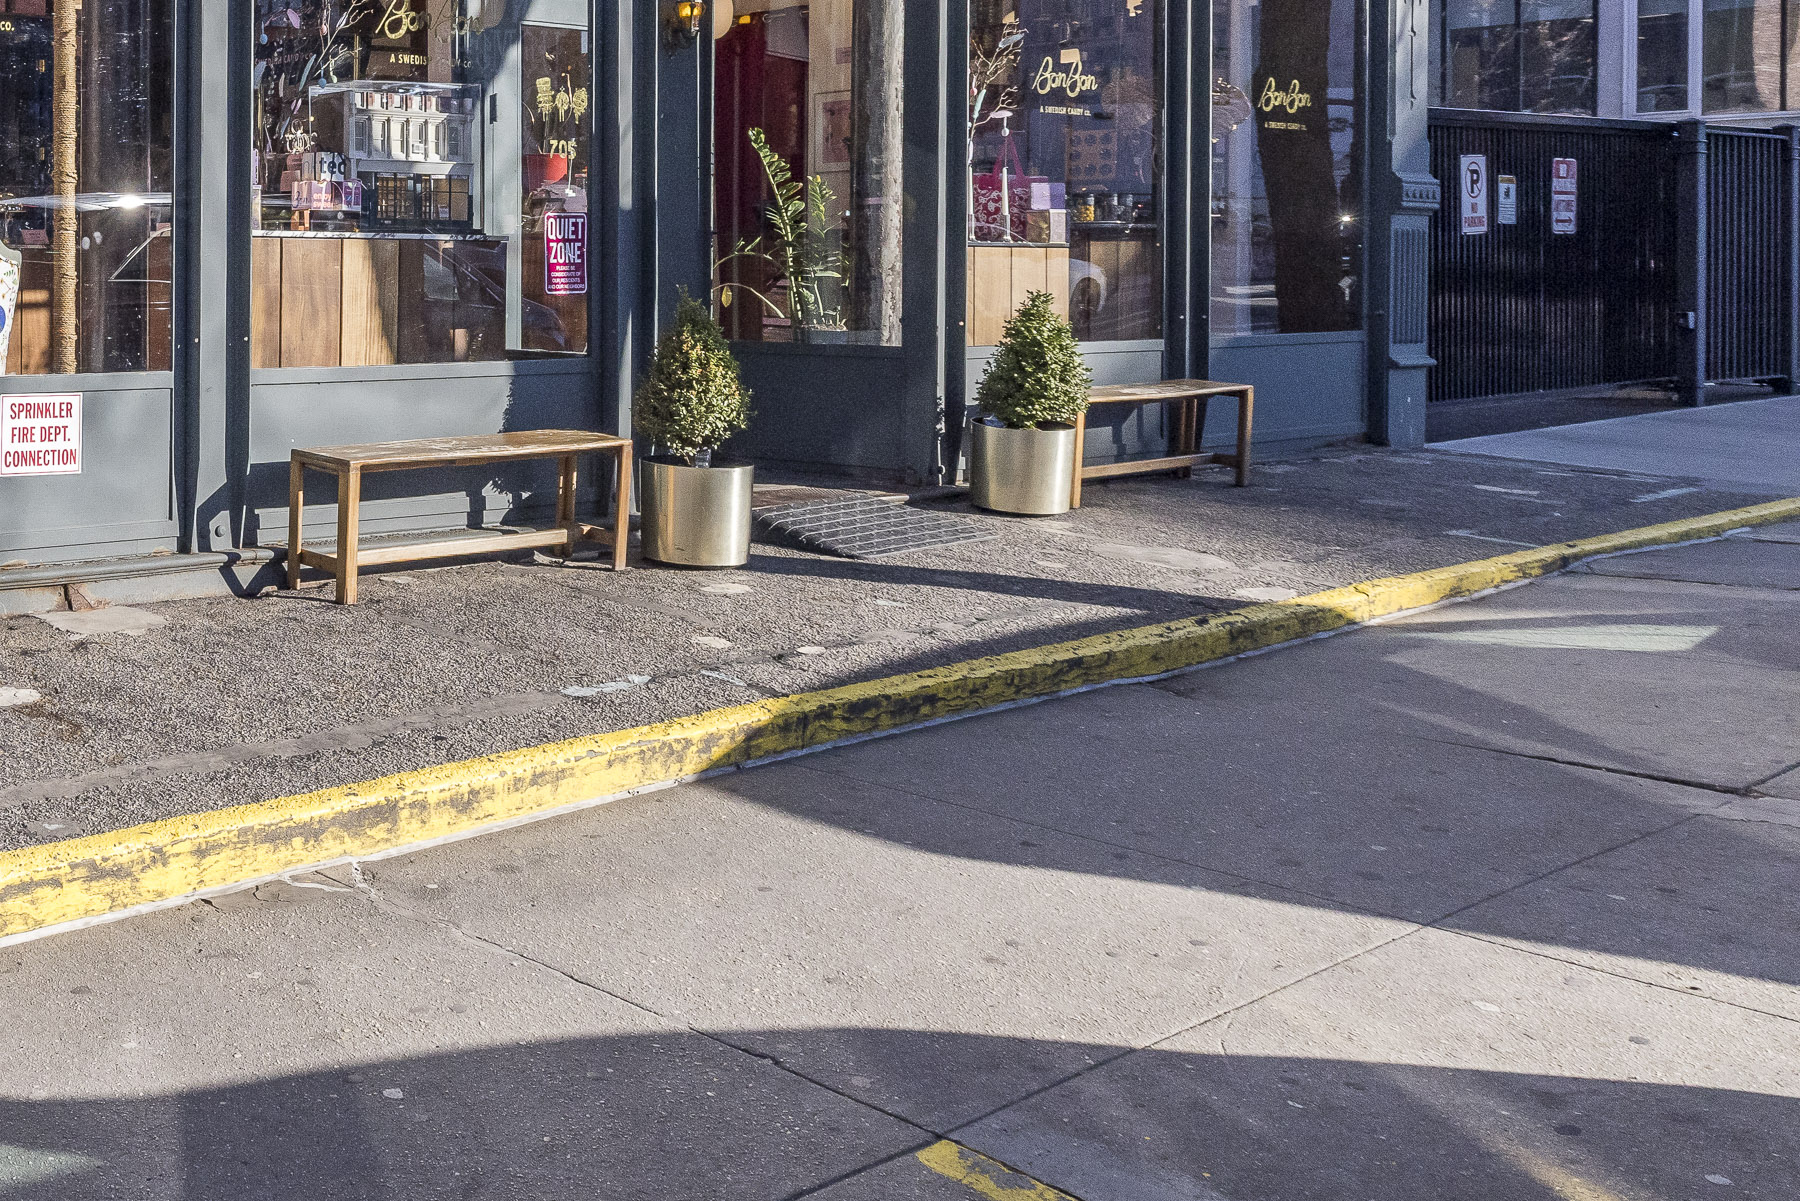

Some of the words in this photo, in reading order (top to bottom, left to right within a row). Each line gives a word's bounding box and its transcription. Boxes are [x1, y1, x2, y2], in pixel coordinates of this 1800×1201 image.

[0, 20, 15, 32] CO.
[389, 53, 396, 63] A
[398, 54, 432, 66] SWEDIS
[549, 139, 577, 160] 705
[547, 217, 584, 241] QUIET
[1464, 216, 1485, 227] PARKING
[549, 242, 582, 264] ZONE
[9, 402, 73, 420] SPRINKLER
[11, 426, 36, 443] FIRE
[40, 425, 71, 443] DEPT.
[4, 448, 77, 467] CONNECTION
